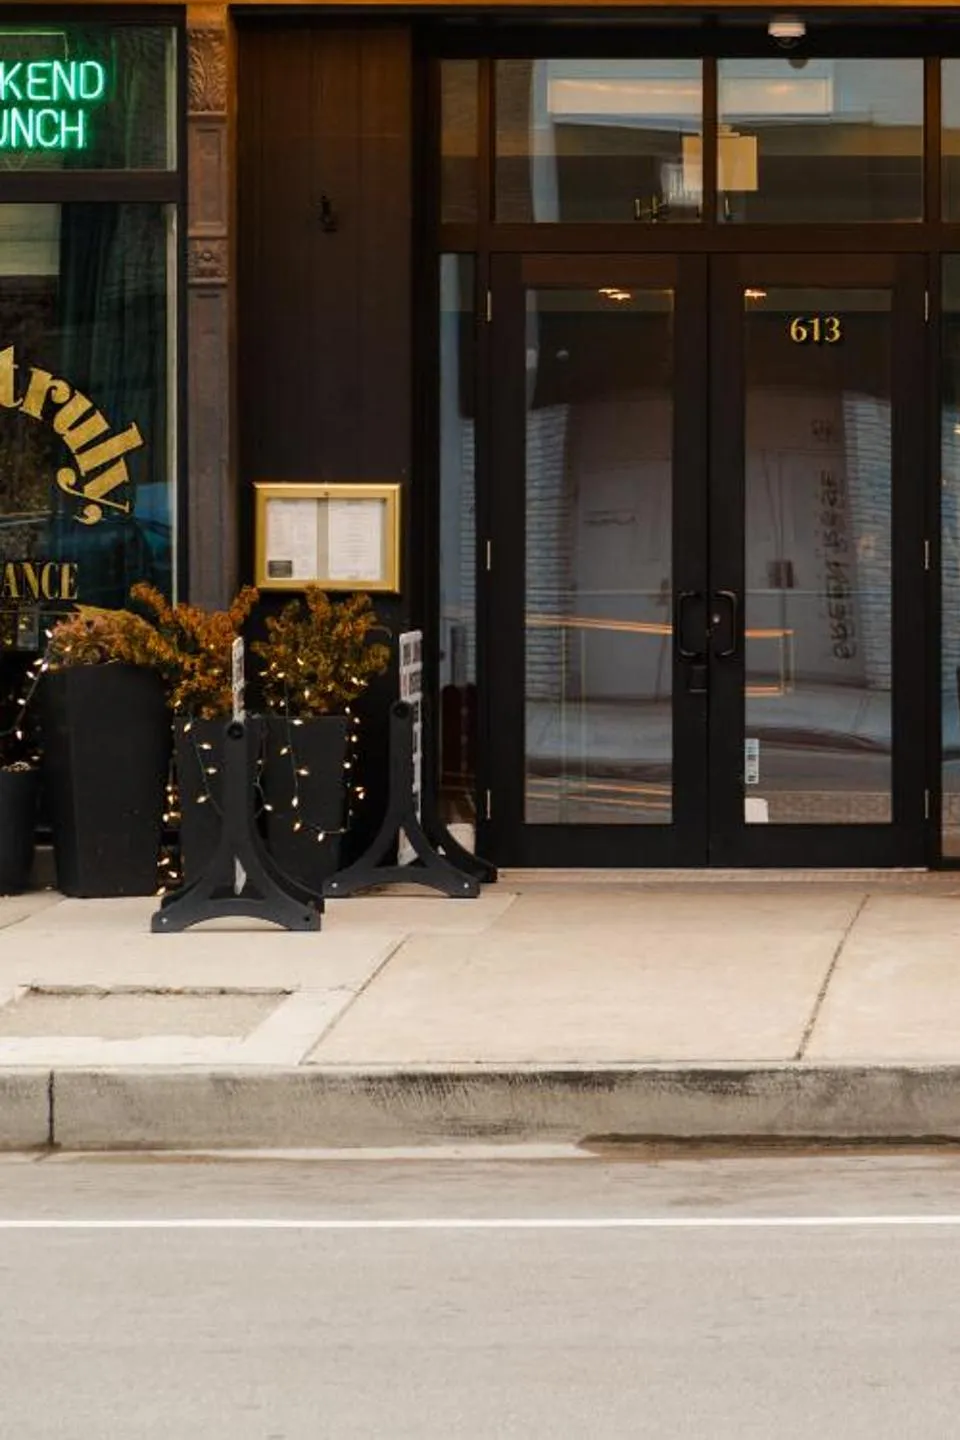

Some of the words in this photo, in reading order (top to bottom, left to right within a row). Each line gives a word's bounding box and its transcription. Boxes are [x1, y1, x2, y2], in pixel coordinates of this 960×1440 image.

[0, 60, 104, 101] KEND
[790, 316, 841, 343] 613
[0, 562, 78, 600] ANCE
